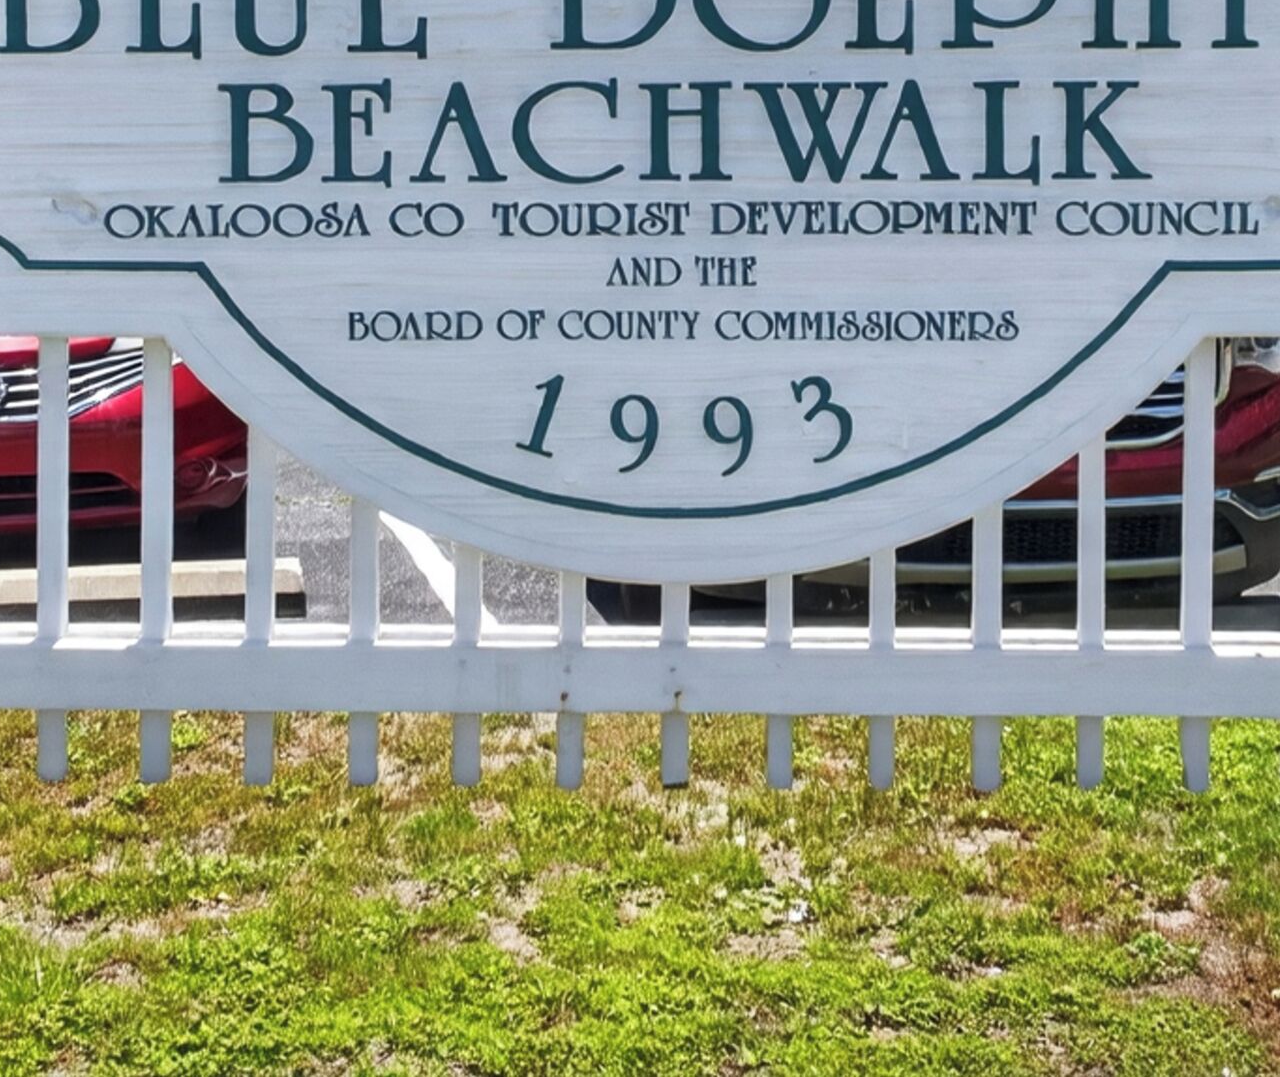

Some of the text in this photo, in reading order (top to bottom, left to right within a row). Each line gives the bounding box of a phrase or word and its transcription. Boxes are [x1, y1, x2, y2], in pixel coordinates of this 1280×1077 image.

[218, 78, 1152, 188] BEACHWALK
[104, 200, 1259, 239] OKALOOSA CO TOURIST DEVELOPMENT COUNCIL
[606, 256, 757, 286] AND THE
[349, 310, 1019, 341] BOARD OF COUNTY COMMISSIONERS
[516, 374, 853, 477] 1993
